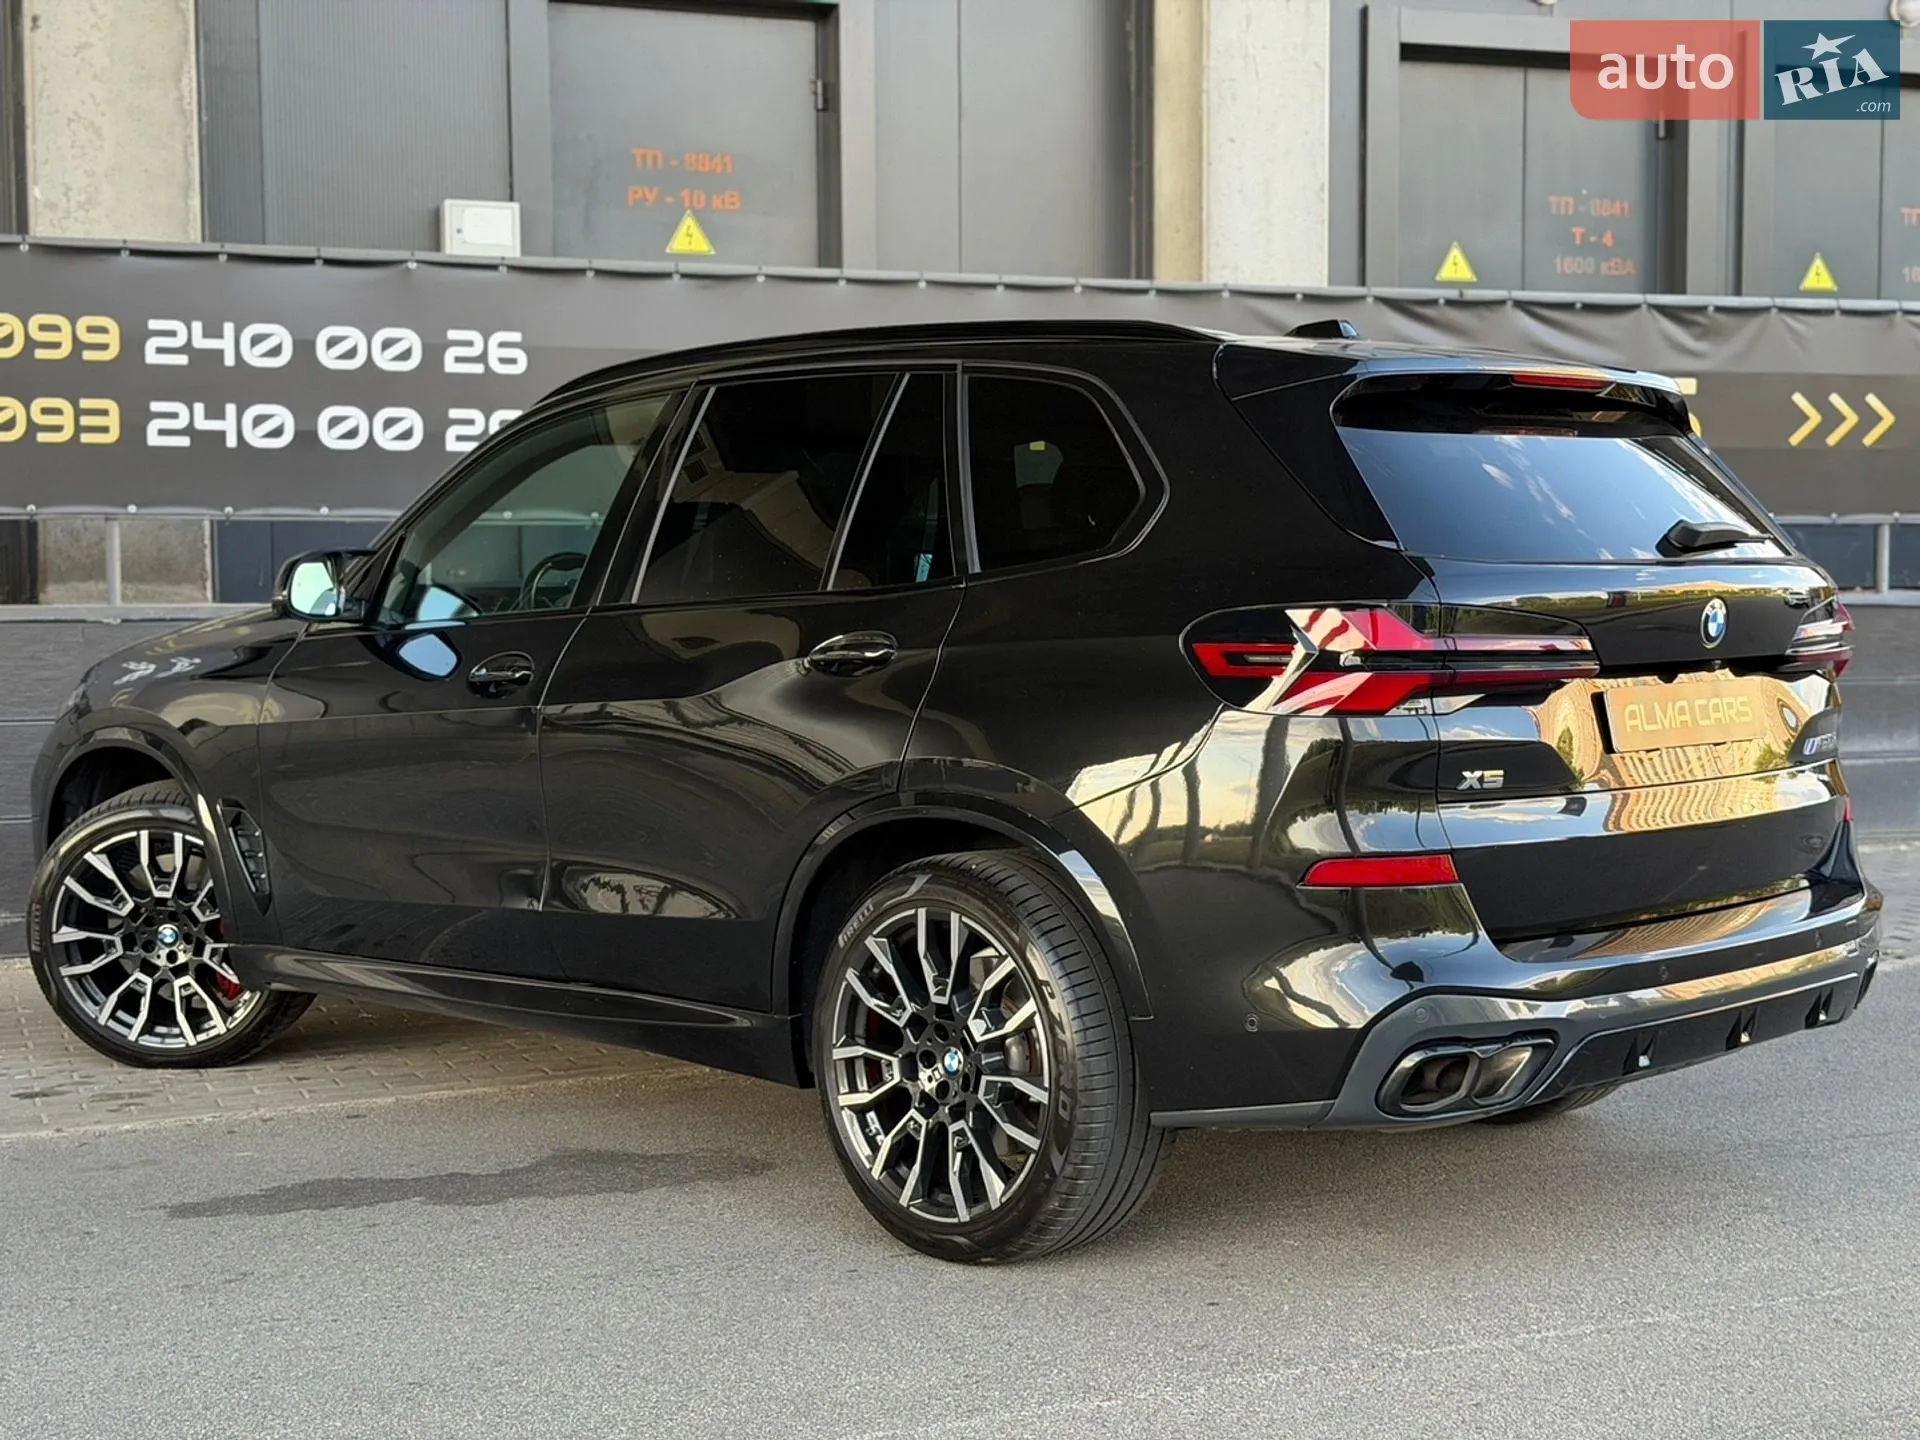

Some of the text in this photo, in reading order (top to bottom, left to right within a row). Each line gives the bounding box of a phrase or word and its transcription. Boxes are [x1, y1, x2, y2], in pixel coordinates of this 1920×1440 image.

[681, 188, 707, 210] 10
[143, 317, 293, 369] 240
[315, 325, 423, 372] 00
[443, 327, 529, 376] 26
[146, 400, 295, 449] 240
[316, 403, 424, 451] 00
[1624, 695, 1755, 733] ALMA CARS
[1456, 768, 1504, 792] X5
